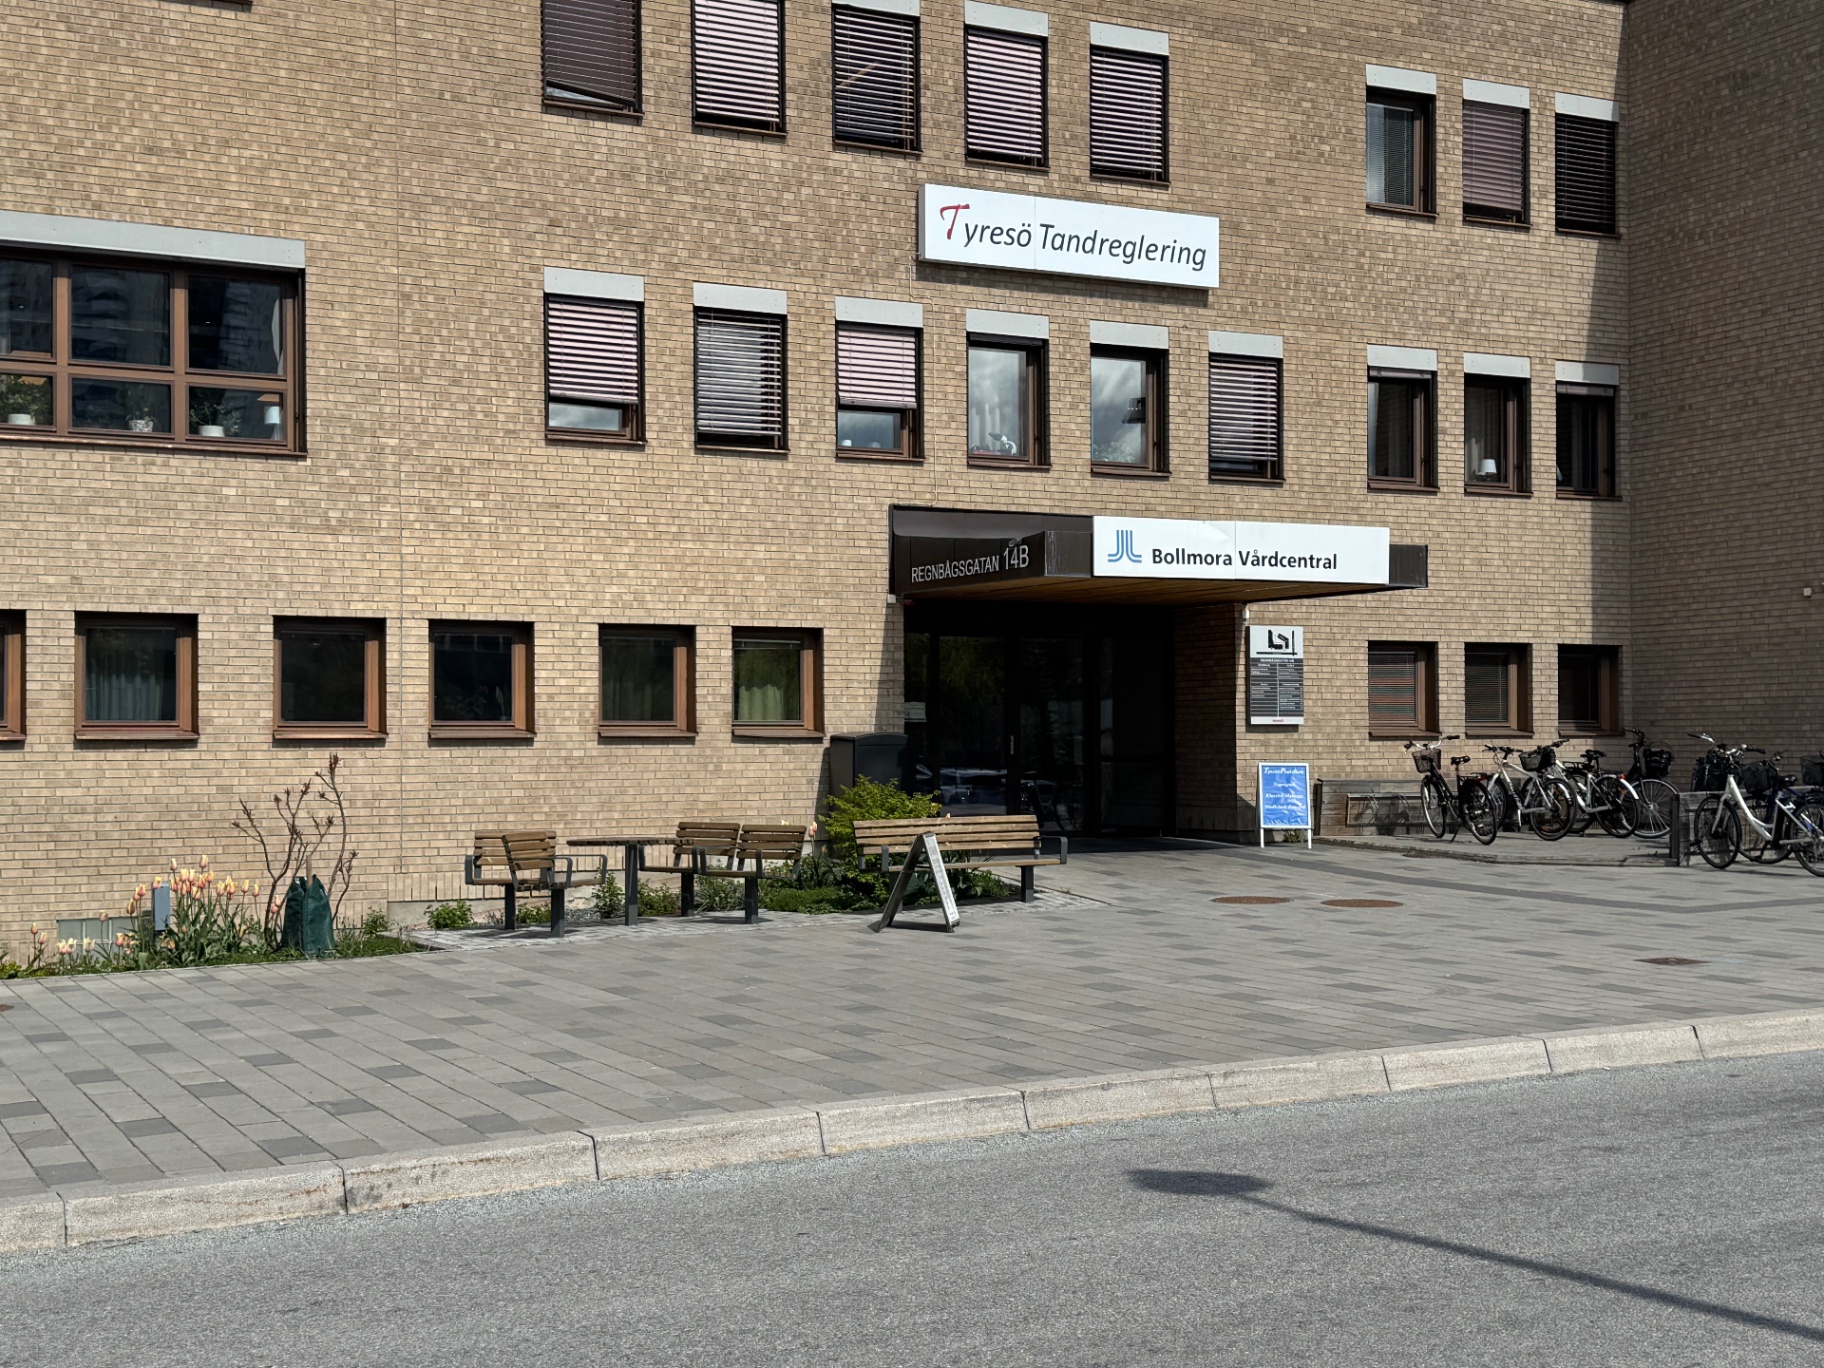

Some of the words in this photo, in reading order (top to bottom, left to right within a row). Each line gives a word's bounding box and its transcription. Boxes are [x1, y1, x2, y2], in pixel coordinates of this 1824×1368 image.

[939, 203, 1032, 247] Tyresö
[1039, 223, 1207, 272] Tandreglering
[911, 555, 1000, 583] REGNBÅGSGATAN
[1003, 545, 1029, 570] 14B
[1151, 548, 1233, 566] Bollmora
[1238, 549, 1337, 569] Vårdcentral
